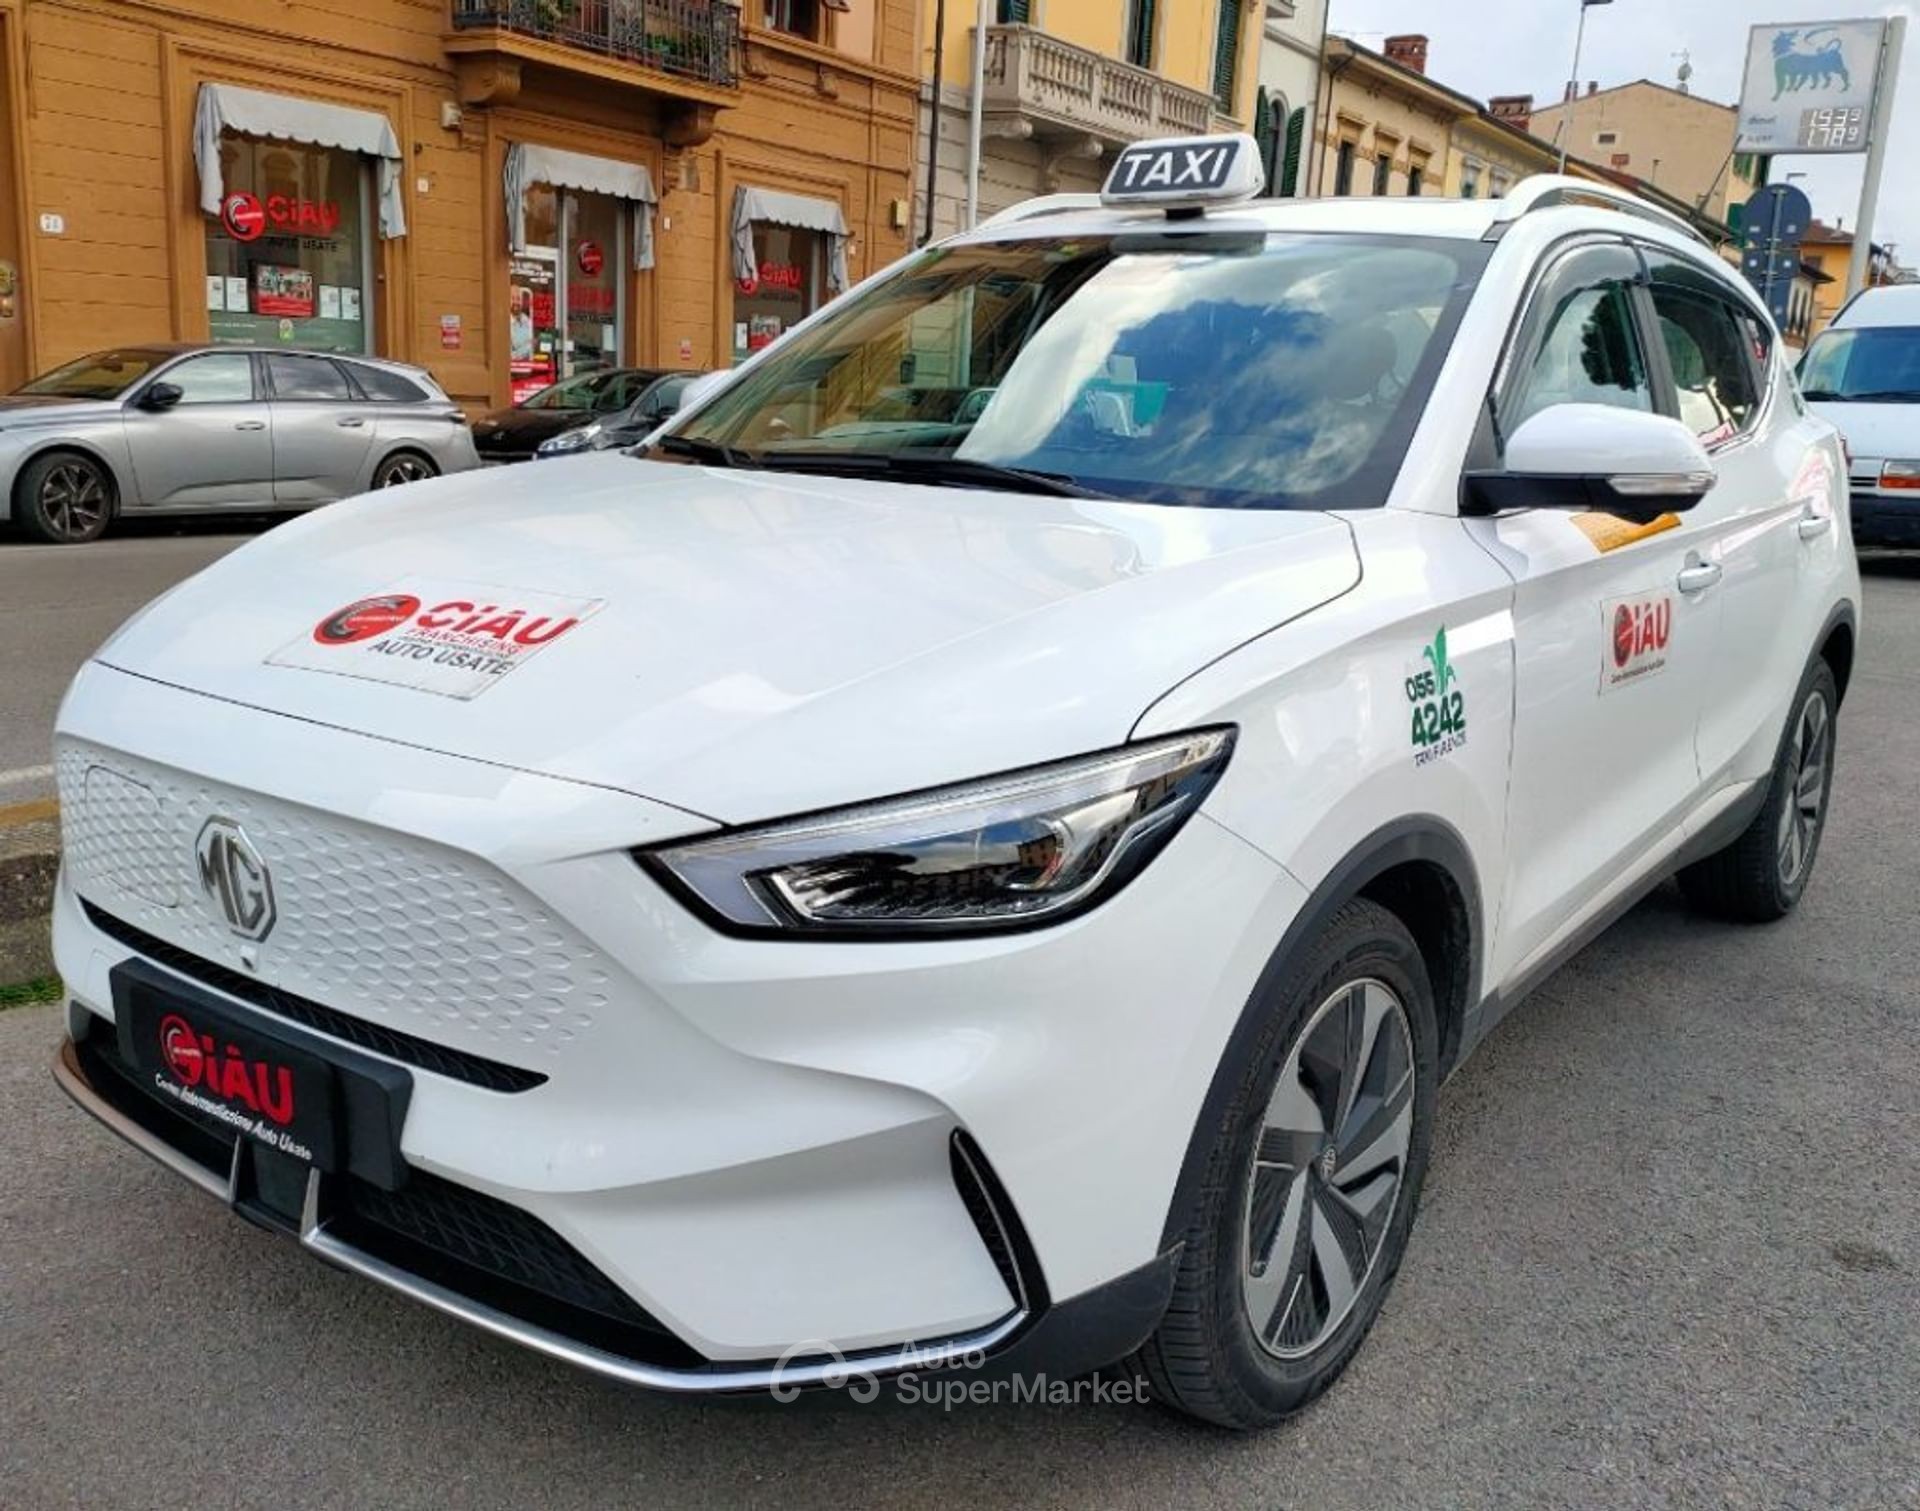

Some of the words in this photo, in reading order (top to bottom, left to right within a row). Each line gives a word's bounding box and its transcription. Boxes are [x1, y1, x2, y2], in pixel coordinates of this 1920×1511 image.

[1124, 147, 1229, 188] TAXI
[368, 639, 434, 660] AUTO
[433, 651, 513, 675] USATE
[1412, 690, 1465, 747] 4242
[199, 829, 266, 931] MG
[250, 1119, 279, 1146] Auto
[278, 1132, 313, 1161] Usate
